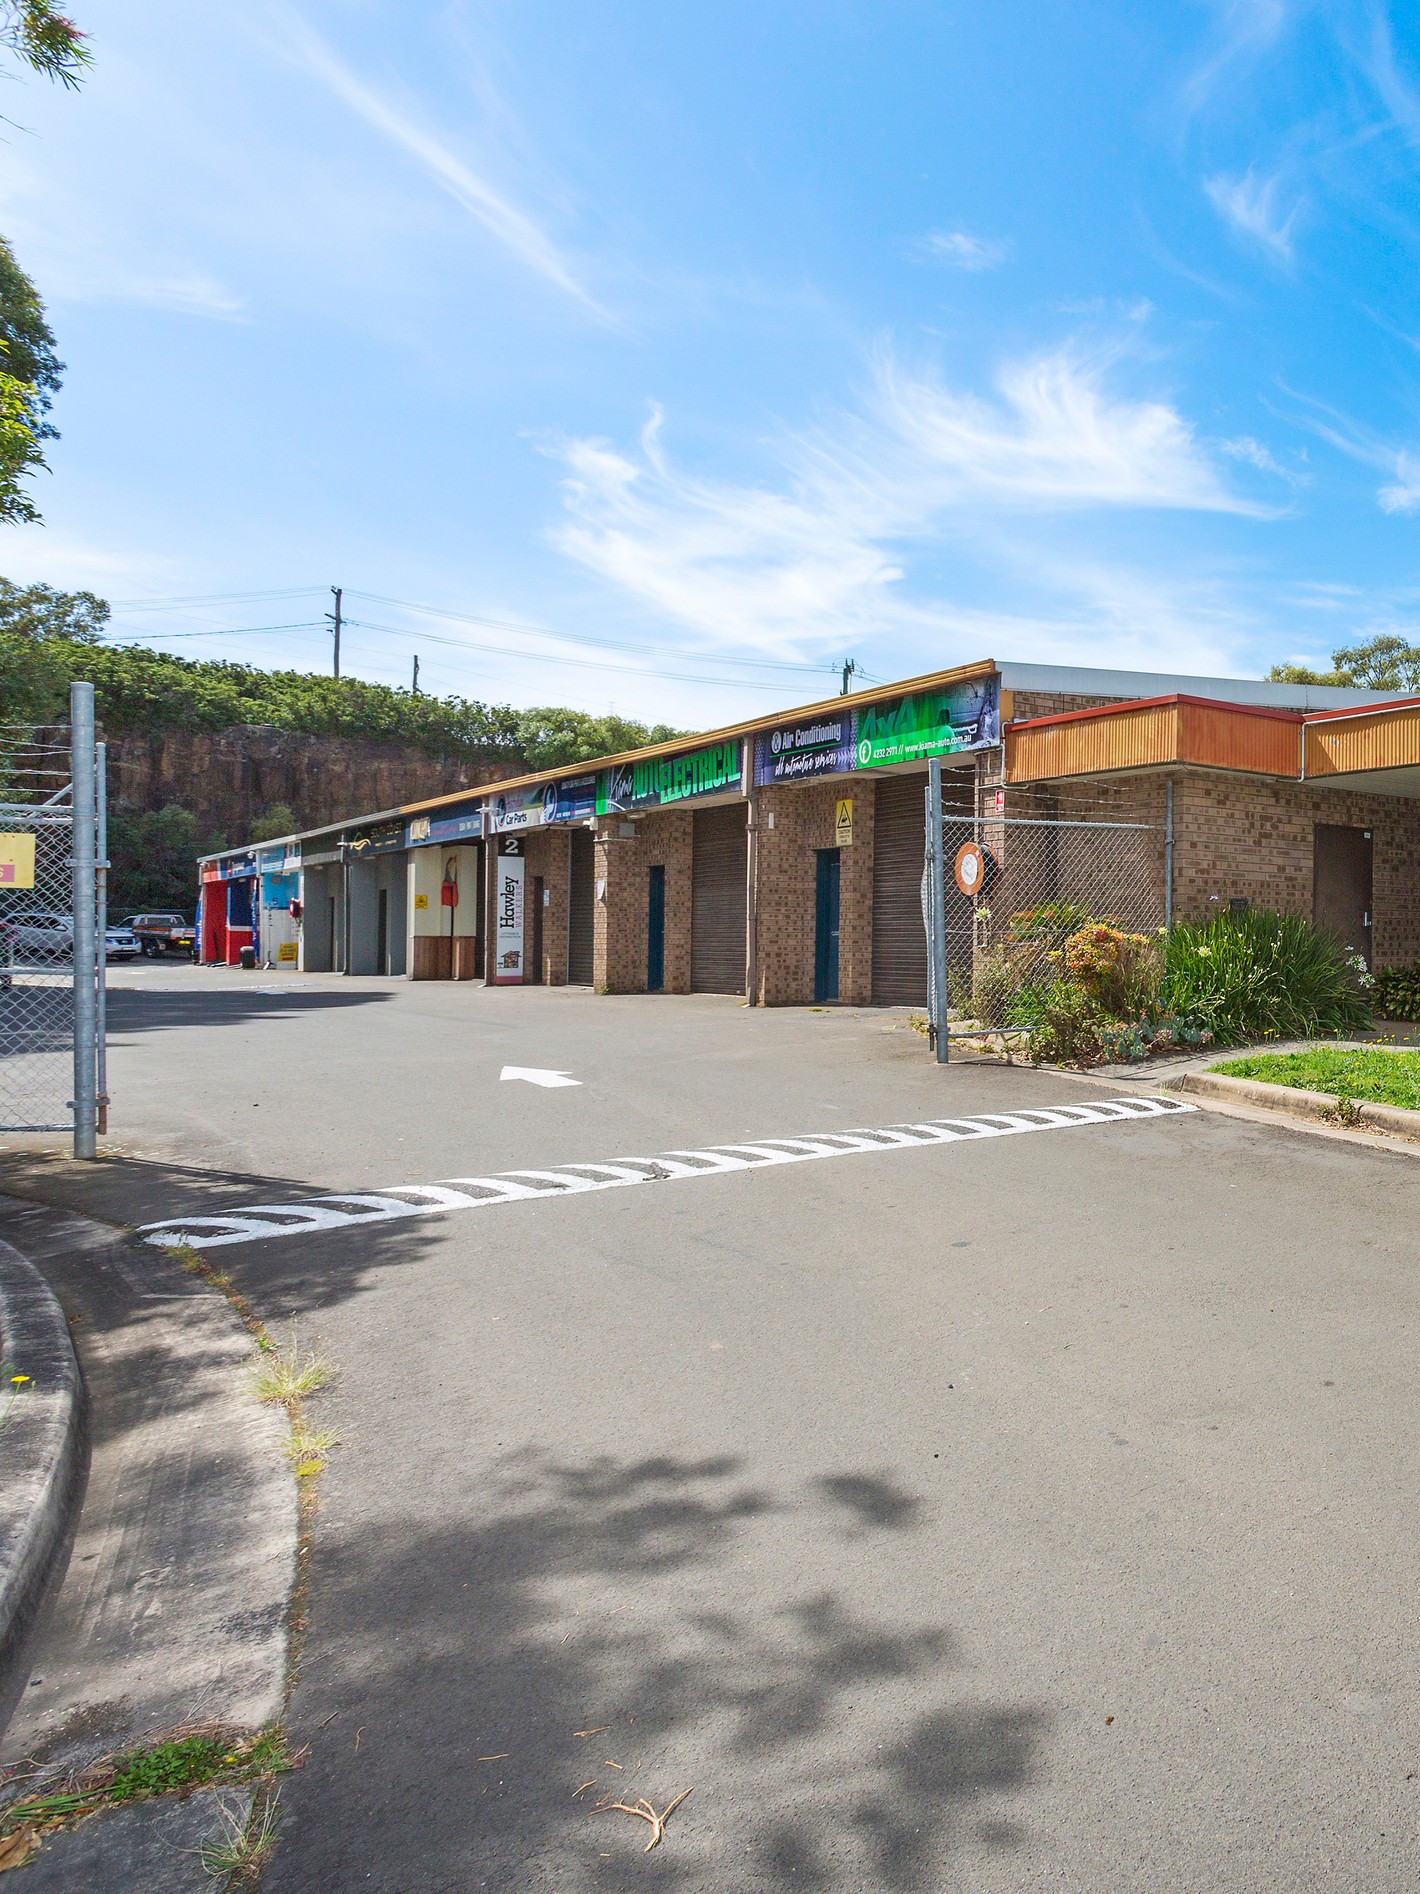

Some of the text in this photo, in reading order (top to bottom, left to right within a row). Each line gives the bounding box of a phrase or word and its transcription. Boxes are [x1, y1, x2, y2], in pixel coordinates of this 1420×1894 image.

[782, 722, 842, 750] Air Conditioning
[905, 734, 972, 753] www.kiama-auto.com.au
[631, 755, 664, 801] AUTO
[659, 740, 741, 805] ELECTRICAL
[506, 812, 528, 825] Car Parts
[505, 839, 519, 854] 2
[500, 875, 519, 929] Hawley
[515, 884, 523, 928] WALKERS
